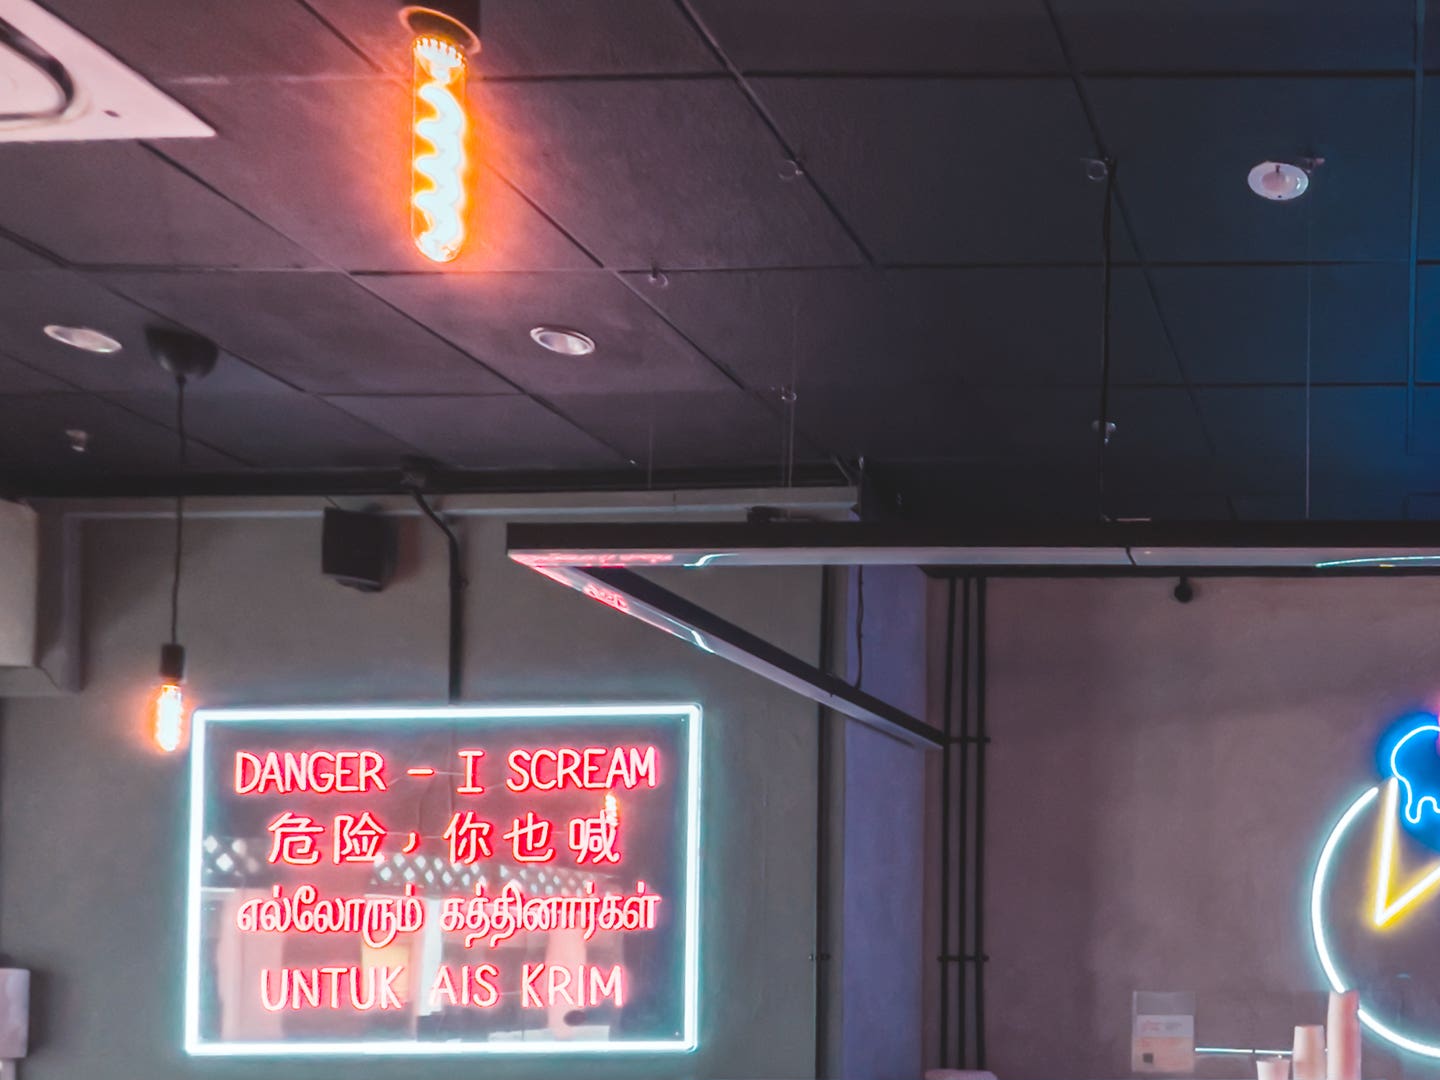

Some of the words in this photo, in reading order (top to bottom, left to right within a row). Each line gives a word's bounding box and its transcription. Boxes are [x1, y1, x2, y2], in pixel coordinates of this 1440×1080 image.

[234, 748, 388, 795] DANGER
[456, 748, 486, 796] I
[505, 744, 659, 791] SCREAM
[258, 963, 406, 1012] UNTUK
[431, 963, 499, 1008] AIS
[518, 961, 624, 1009] KRIM
